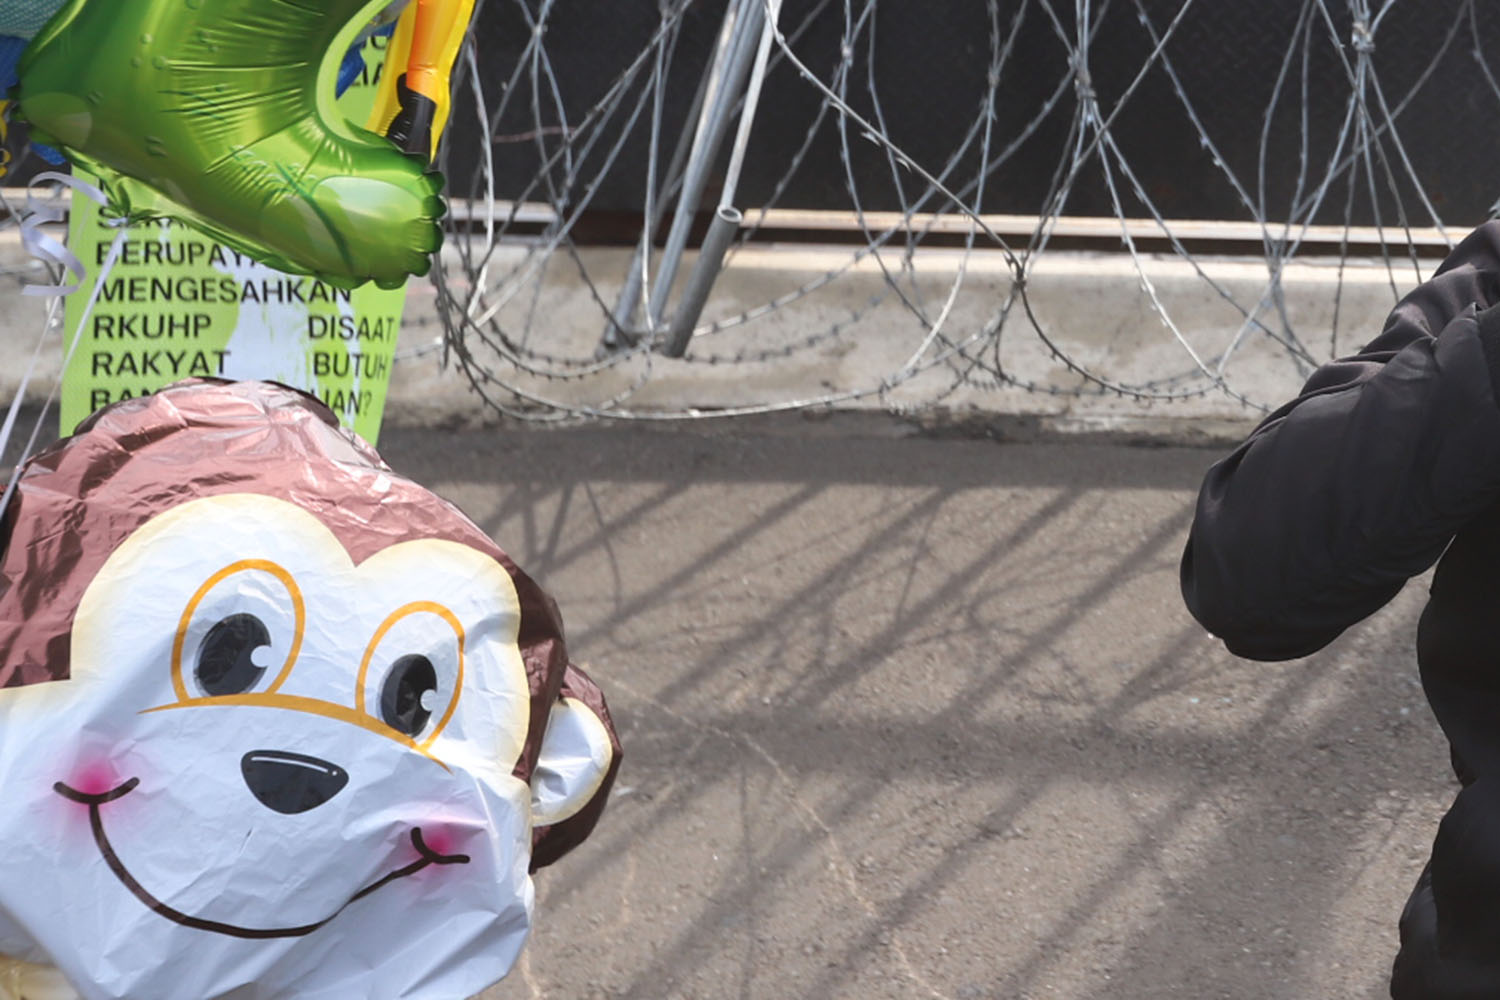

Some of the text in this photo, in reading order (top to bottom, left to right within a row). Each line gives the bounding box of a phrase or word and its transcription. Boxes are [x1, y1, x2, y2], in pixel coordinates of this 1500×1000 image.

[96, 241, 256, 267] BERUPAY
[96, 277, 351, 304] MENGESAHKAN
[93, 313, 394, 342] RKUHP DISAAT
[92, 351, 387, 380] RAKYAT BUTUH
